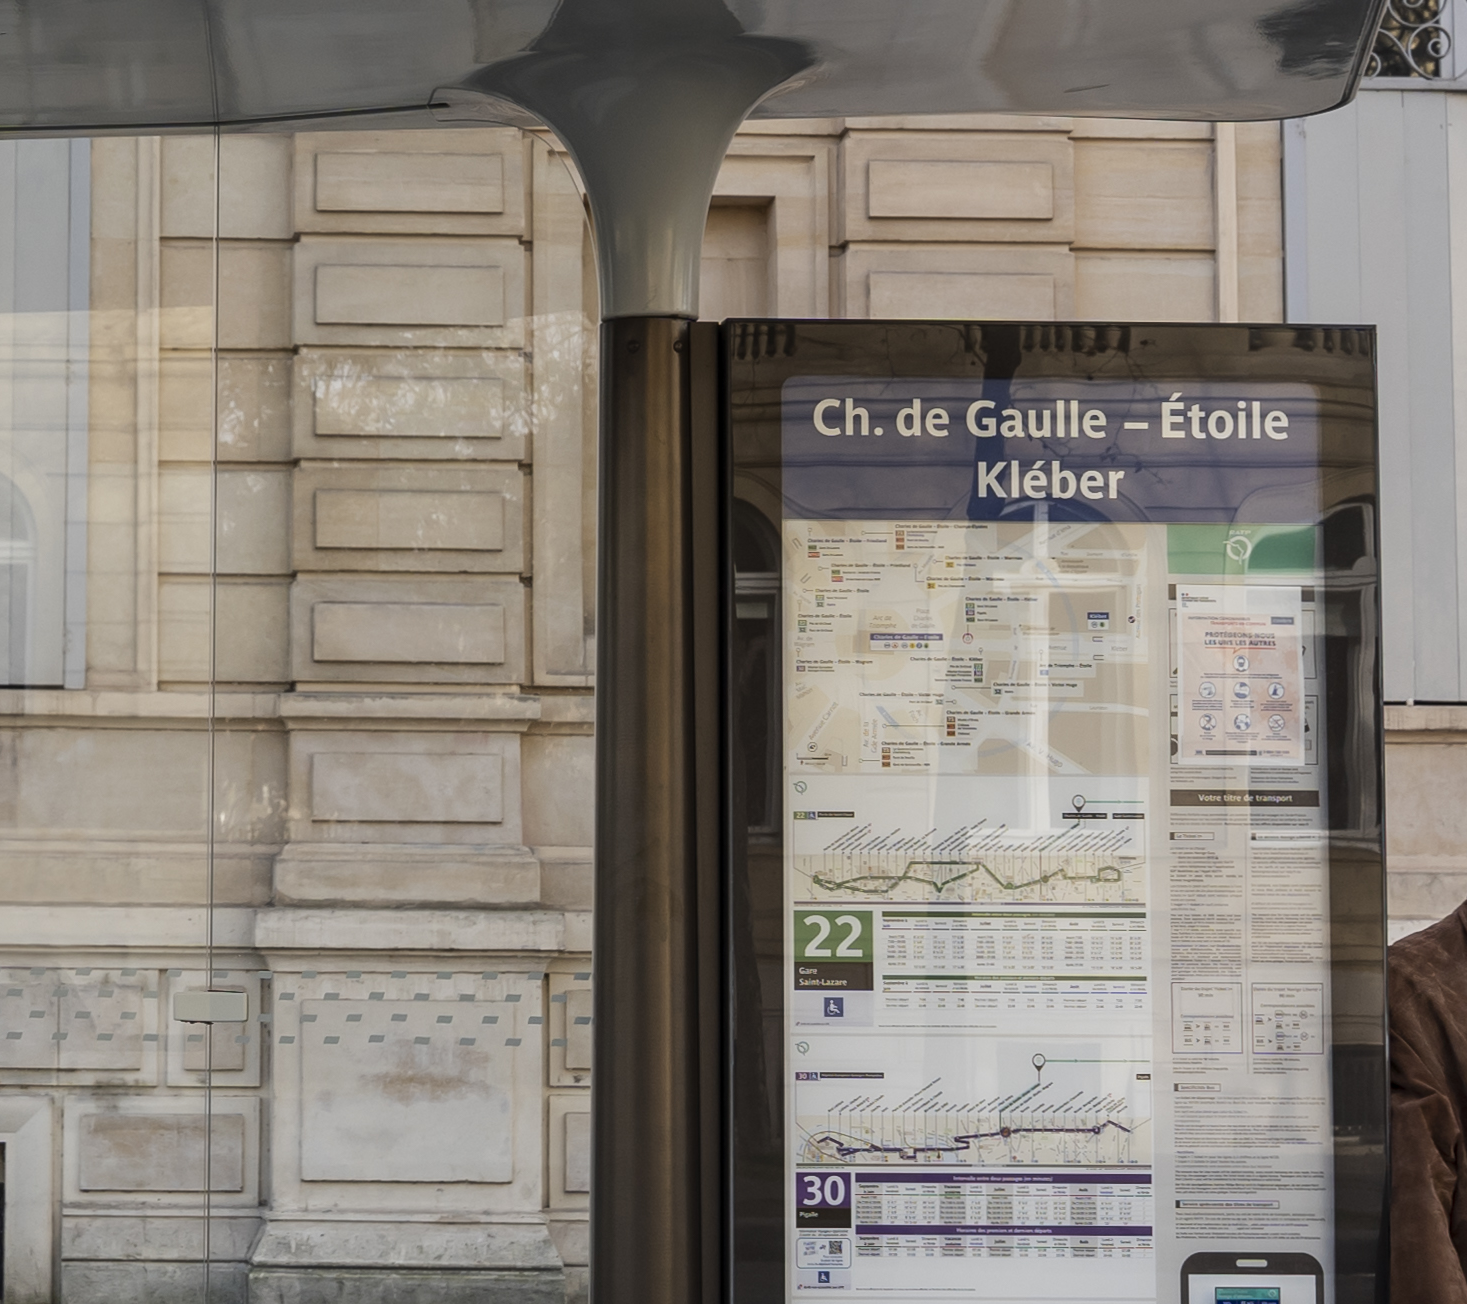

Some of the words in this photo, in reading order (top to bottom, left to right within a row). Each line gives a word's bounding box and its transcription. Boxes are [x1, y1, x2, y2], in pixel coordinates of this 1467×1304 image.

[813, 398, 884, 436] Ch.
[895, 398, 950, 437] de
[966, 399, 1106, 439] Gaulle
[1161, 392, 1288, 440] Étoile
[978, 460, 1125, 499] Kléber
[1198, 794, 1221, 802] Votre
[1223, 794, 1241, 802] titre
[1243, 794, 1253, 802] de
[1255, 794, 1293, 804] transport
[803, 915, 863, 957] 22
[799, 978, 848, 986] Saint-Lazare
[803, 1175, 845, 1206] 30
